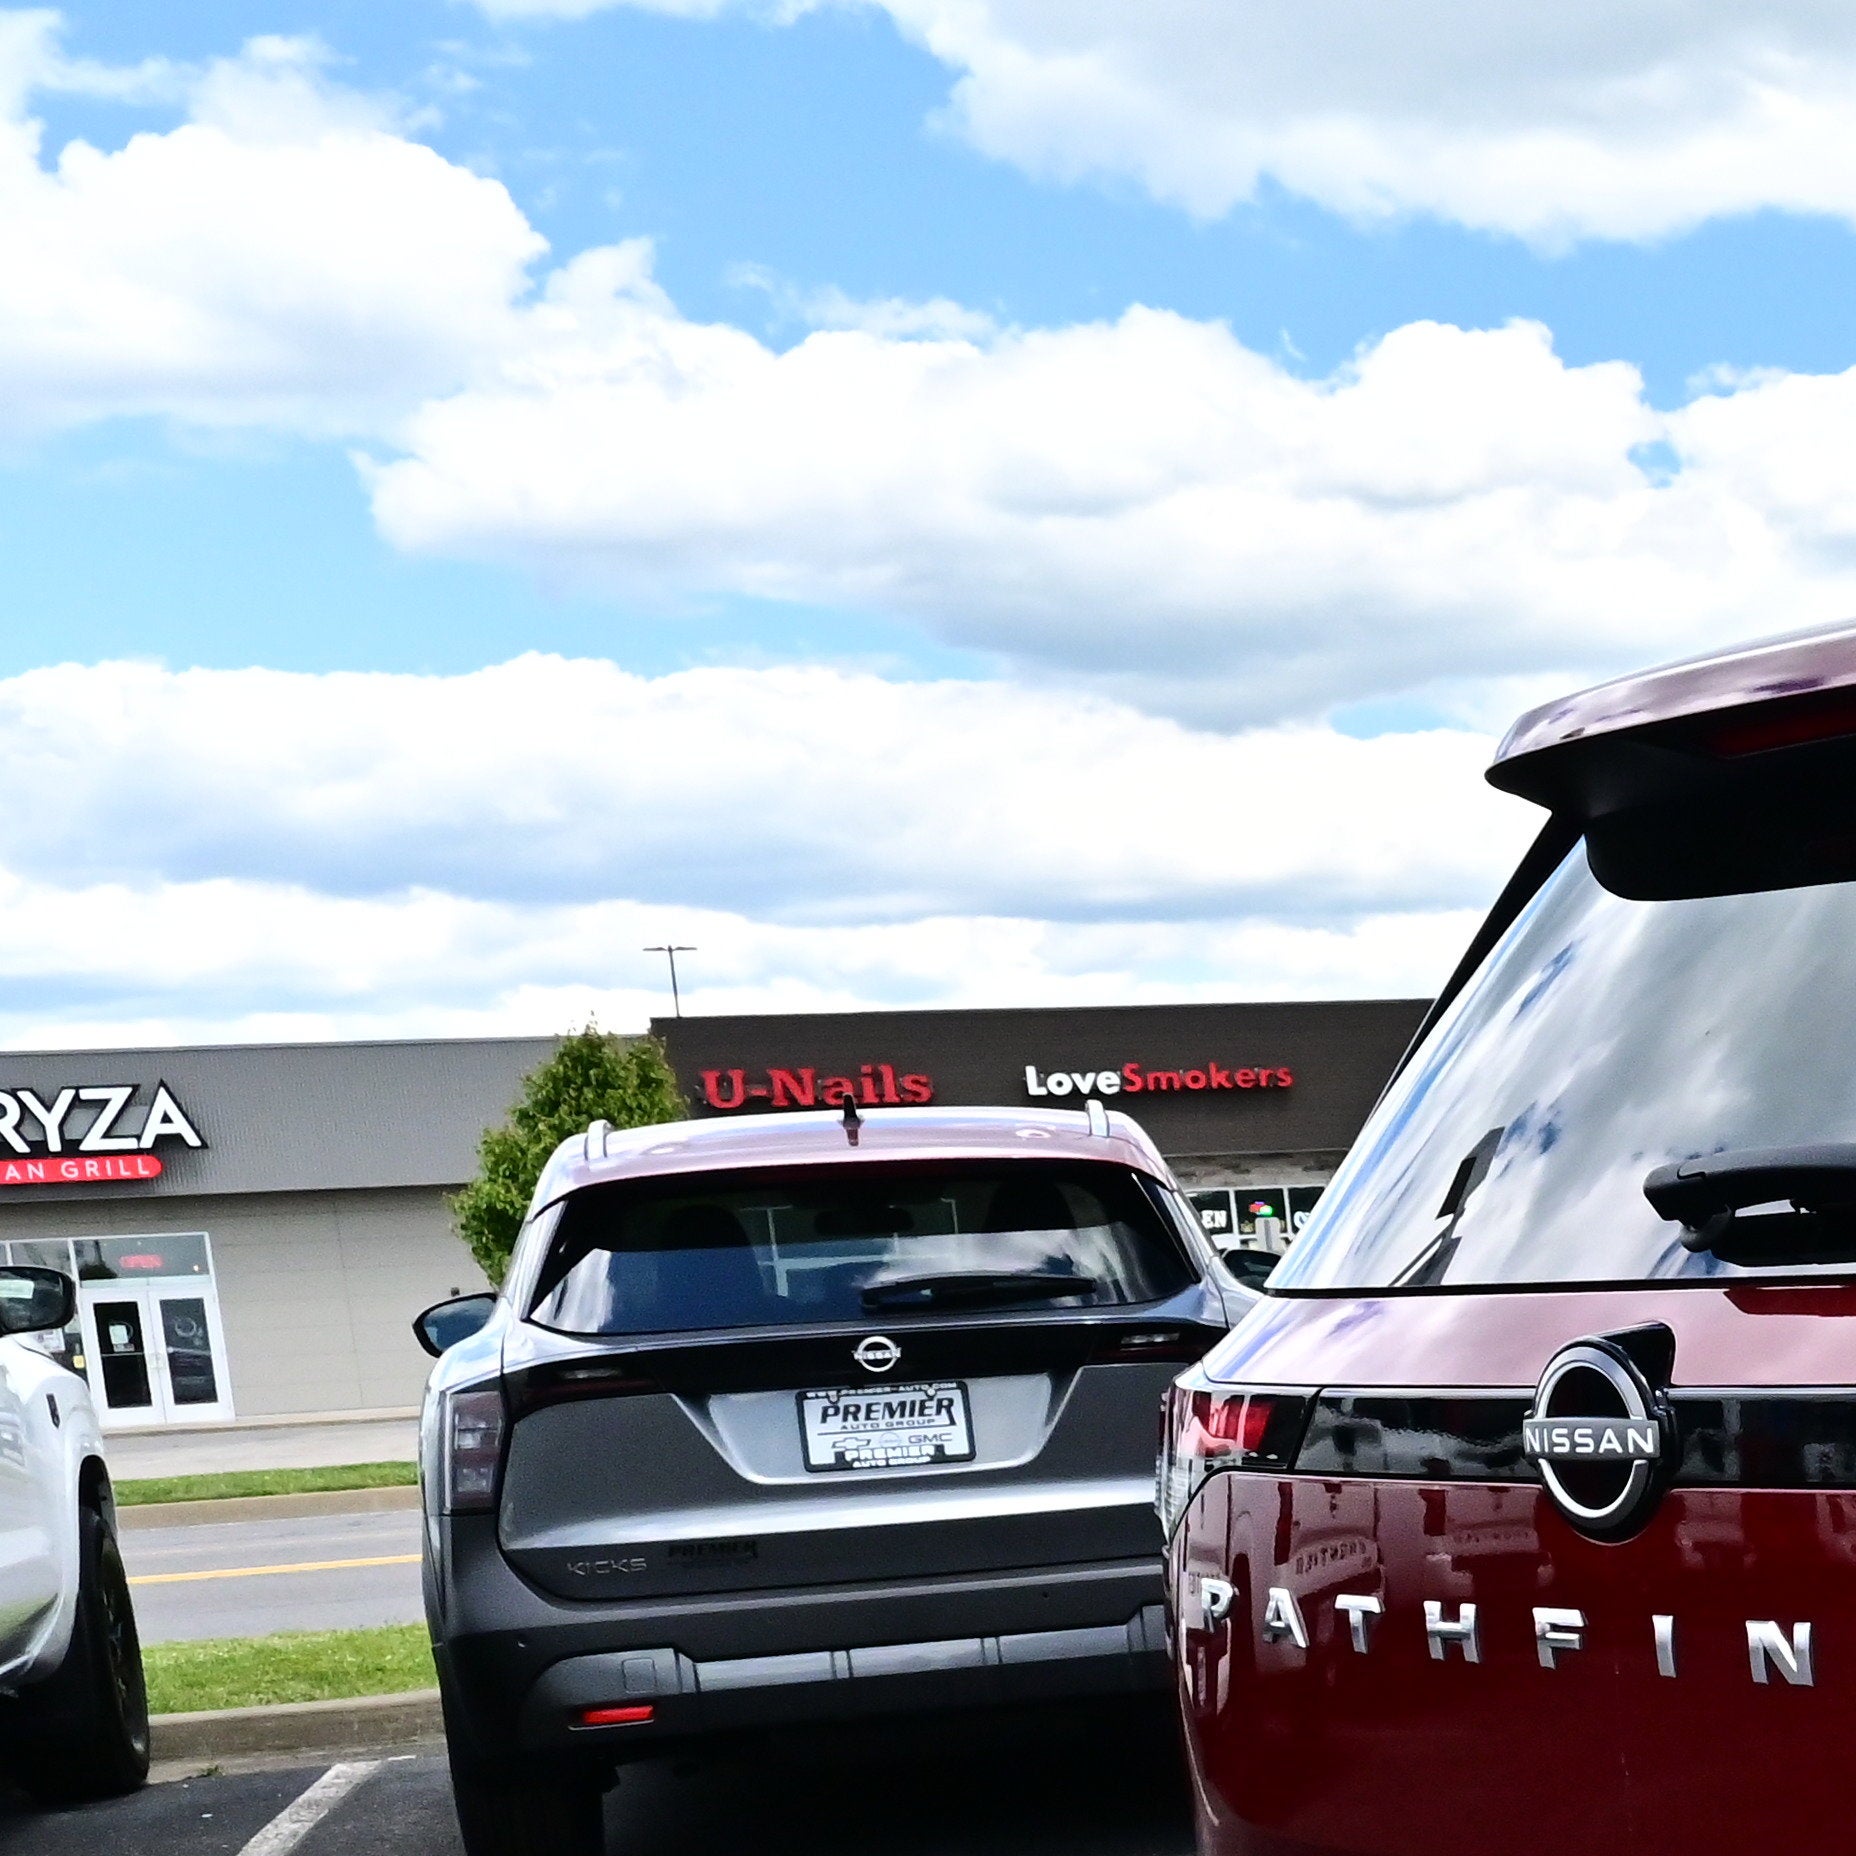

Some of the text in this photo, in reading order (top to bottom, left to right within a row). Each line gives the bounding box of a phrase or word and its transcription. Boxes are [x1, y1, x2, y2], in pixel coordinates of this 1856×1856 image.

[701, 1063, 934, 1109] U-Nails
[0, 1086, 202, 1154] RYZA
[60, 1158, 150, 1179] GRILL
[853, 1348, 901, 1360] NISSAN
[820, 1397, 956, 1430] PREMIER
[840, 1418, 936, 1430] AUTO GROUP
[908, 1432, 952, 1444] GMC
[1525, 1427, 1655, 1454] NISSAN
[844, 1445, 935, 1462] PREMIER
[852, 1458, 886, 1468] AUTO
[566, 1557, 647, 1576] KICKS
